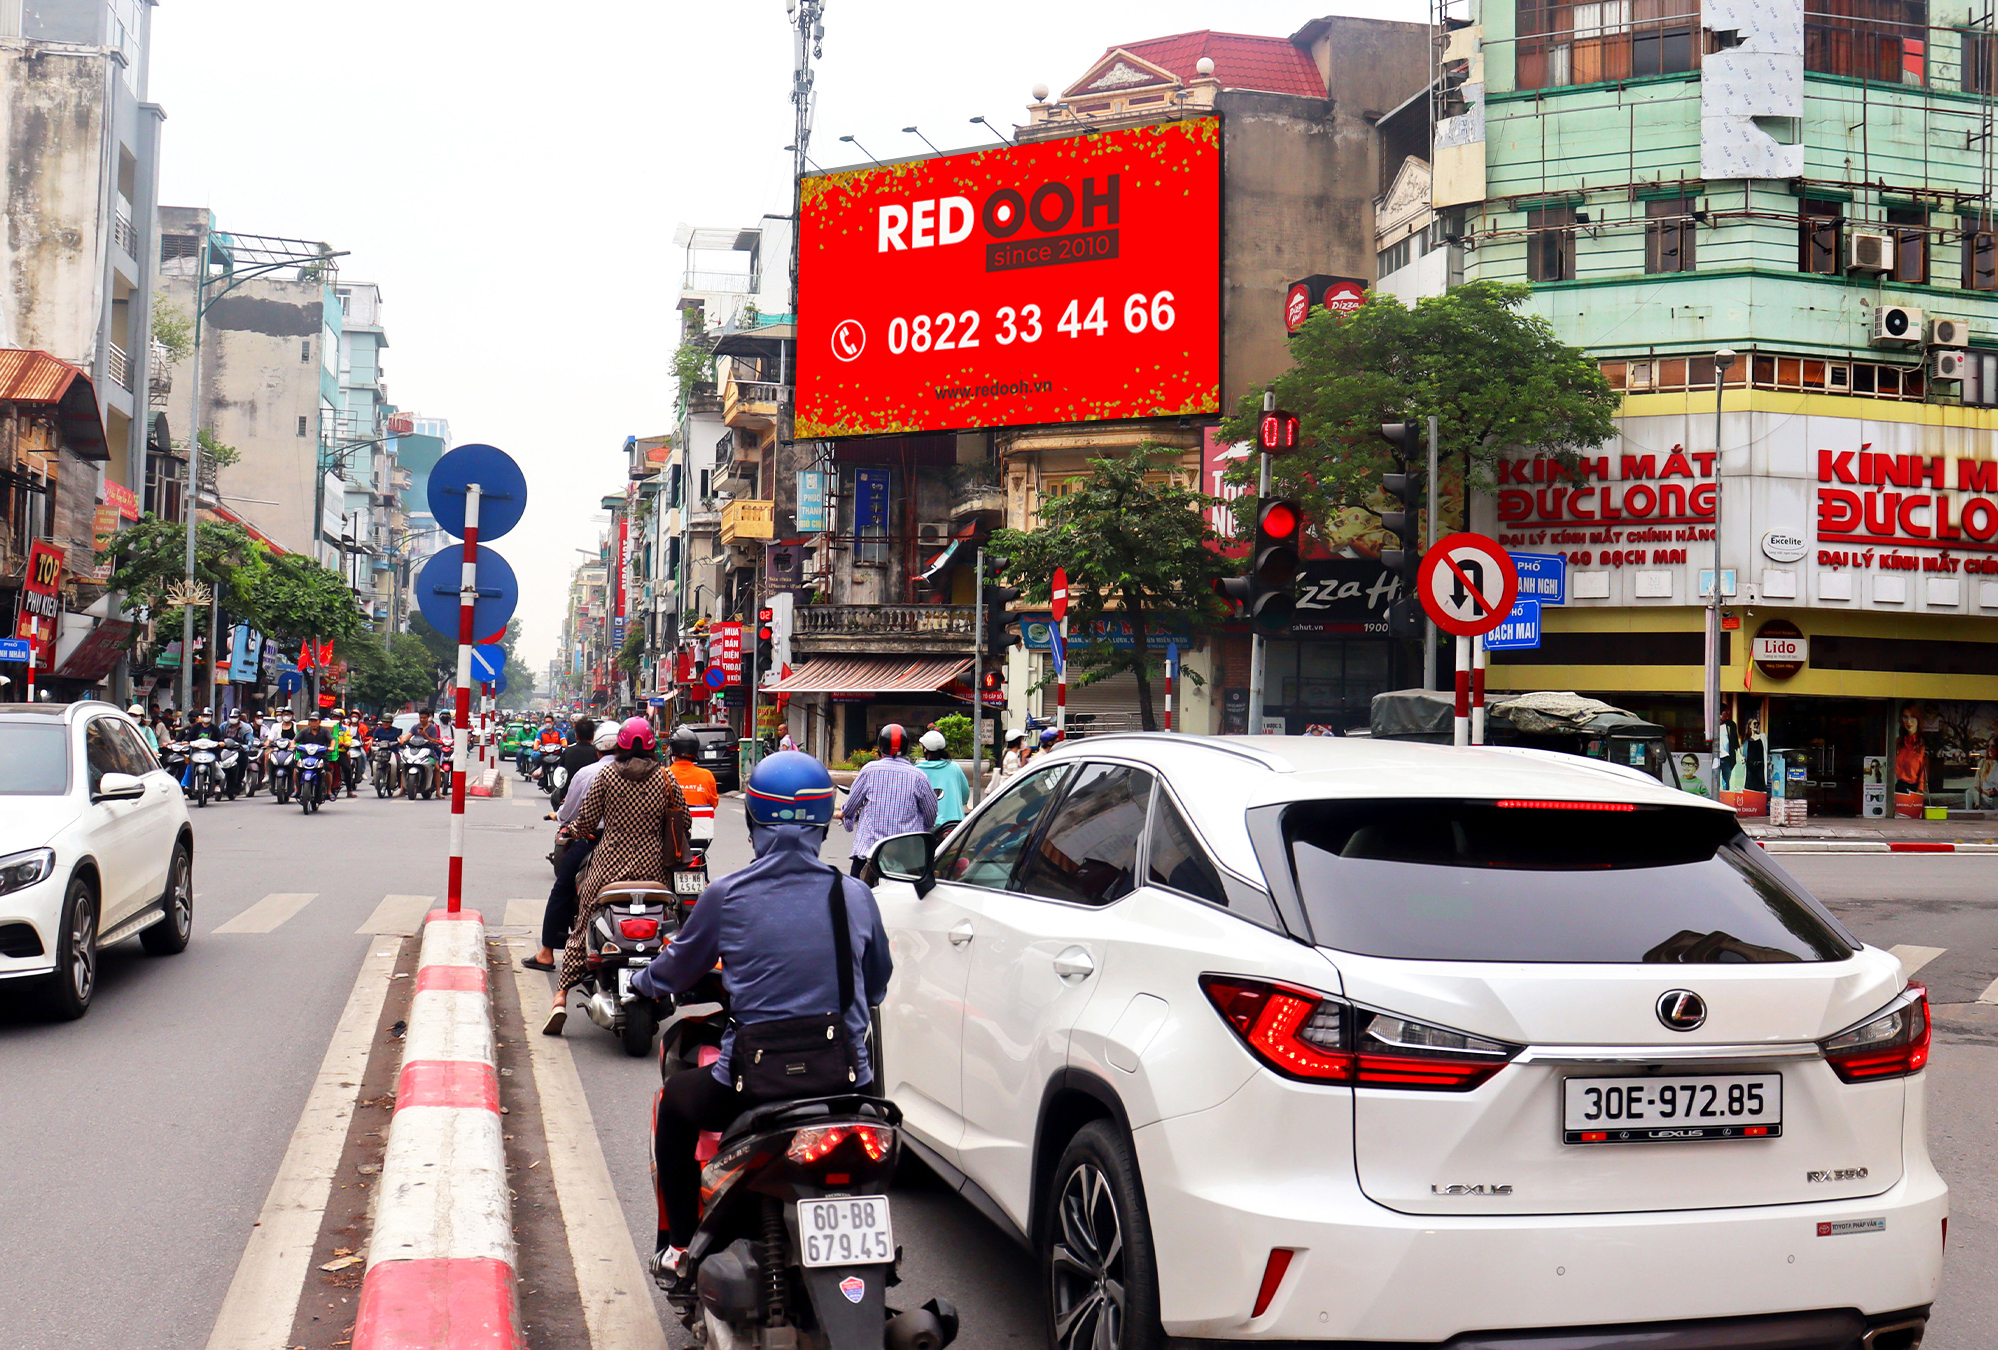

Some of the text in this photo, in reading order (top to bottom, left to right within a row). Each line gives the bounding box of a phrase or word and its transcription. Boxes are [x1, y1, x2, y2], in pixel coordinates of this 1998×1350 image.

[878, 173, 1120, 253] RED OOH
[993, 235, 1110, 267] since 2010
[1289, 301, 1305, 322] Pizza
[1331, 300, 1360, 310] Pizza
[888, 290, 1176, 354] 0822 33 44 66
[935, 379, 1052, 400] www.redooh.vn
[1264, 417, 1293, 447] 01
[1498, 443, 1722, 484] KÍNH MẮT
[1818, 442, 1998, 493] KÍNH M
[1498, 483, 1722, 521] ĐỨC LONG
[1817, 486, 1931, 538] ĐỨC
[1499, 532, 1525, 547] ĐẠI
[1529, 530, 1547, 544] LÝ
[1550, 529, 1586, 544] KÍNH
[1590, 526, 1622, 544] MẮT
[1626, 526, 1672, 542] CHÍNH
[1770, 538, 1802, 546] Excelite
[1518, 560, 1541, 571] PHỐ
[1600, 549, 1646, 568] BẠCH
[1653, 549, 1687, 564] MAI
[1818, 550, 1848, 570] ĐẠI
[1852, 548, 1874, 568] LÝ
[1880, 549, 1919, 570] KÍNH
[1923, 550, 1960, 572] MẮT
[38, 554, 60, 586] TOP
[1296, 571, 1362, 610] zza
[1538, 578, 1558, 598] NGHỊ
[760, 612, 770, 620] 02
[1511, 604, 1524, 616] HỐ
[724, 628, 739, 636] MUA
[1364, 623, 1388, 632] 1900
[1488, 622, 1535, 644] BẠCH MAI
[724, 639, 738, 648] BÁN
[1765, 640, 1796, 654] Lido
[724, 651, 739, 660] ĐIỆN
[1584, 1083, 1764, 1120] 30E-972.85
[1648, 1130, 1704, 1138] LEXUS
[1806, 1169, 1832, 1183] RX
[1431, 1183, 1512, 1196] LEXUS
[814, 1202, 876, 1232] 60-B8
[807, 1232, 888, 1262] 679.45
